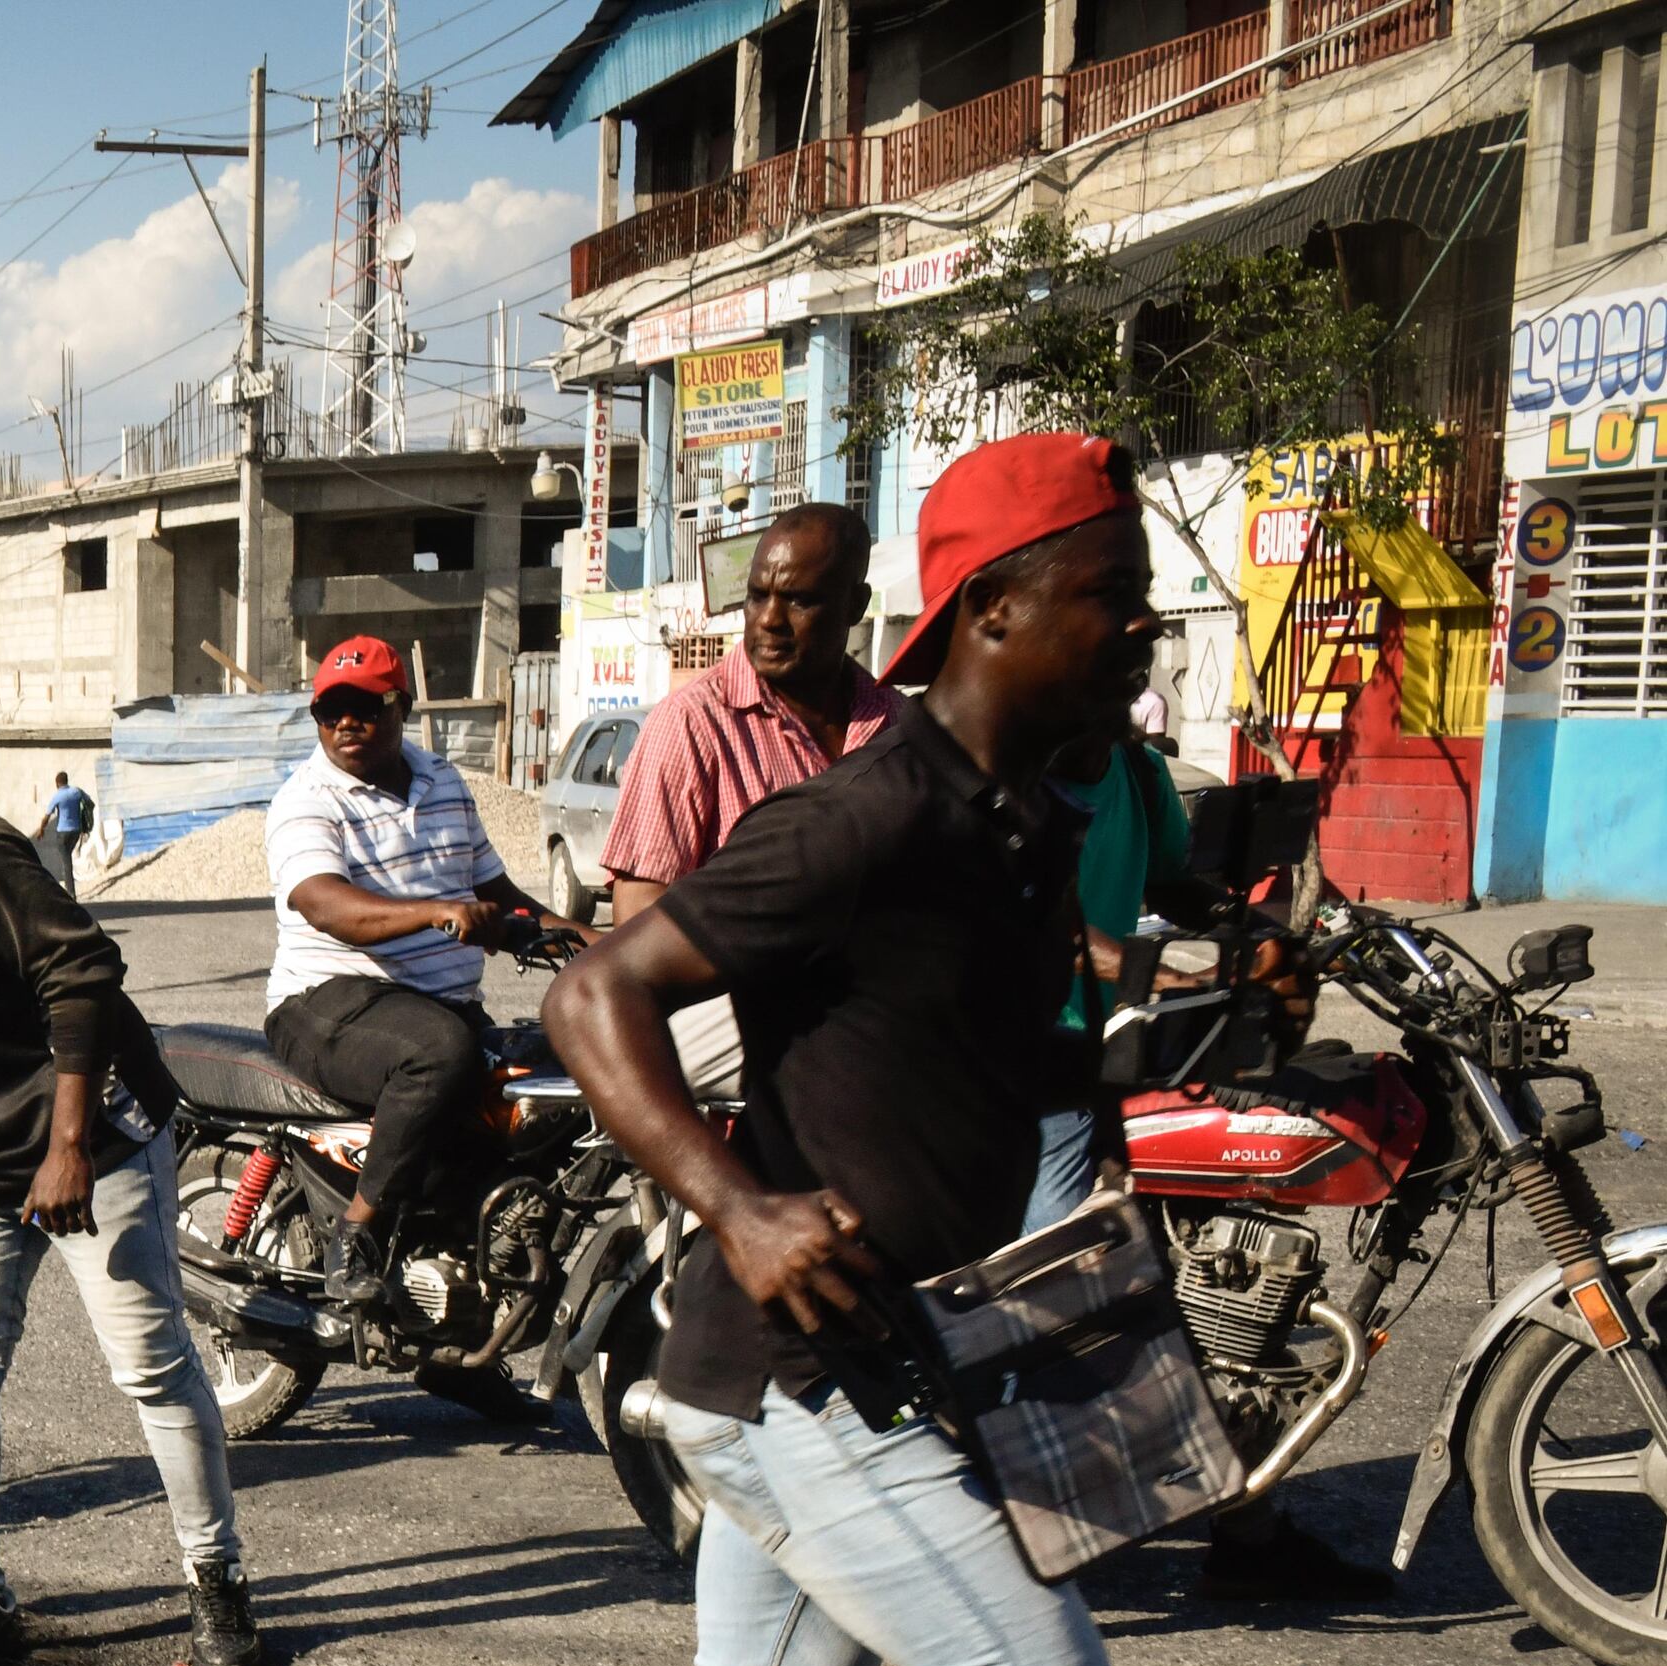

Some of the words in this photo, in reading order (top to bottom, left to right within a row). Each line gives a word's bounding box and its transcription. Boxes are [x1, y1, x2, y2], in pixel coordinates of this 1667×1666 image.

[882, 257, 940, 299] CLAUDY
[681, 356, 737, 388] CLAUDY
[741, 349, 779, 379] FRESH
[696, 380, 765, 406] STORE
[683, 423, 709, 435] POUR
[713, 417, 751, 430] HOMMES
[1490, 482, 1520, 686] EXTRA
[1221, 1149, 1282, 1162] APOLLO
